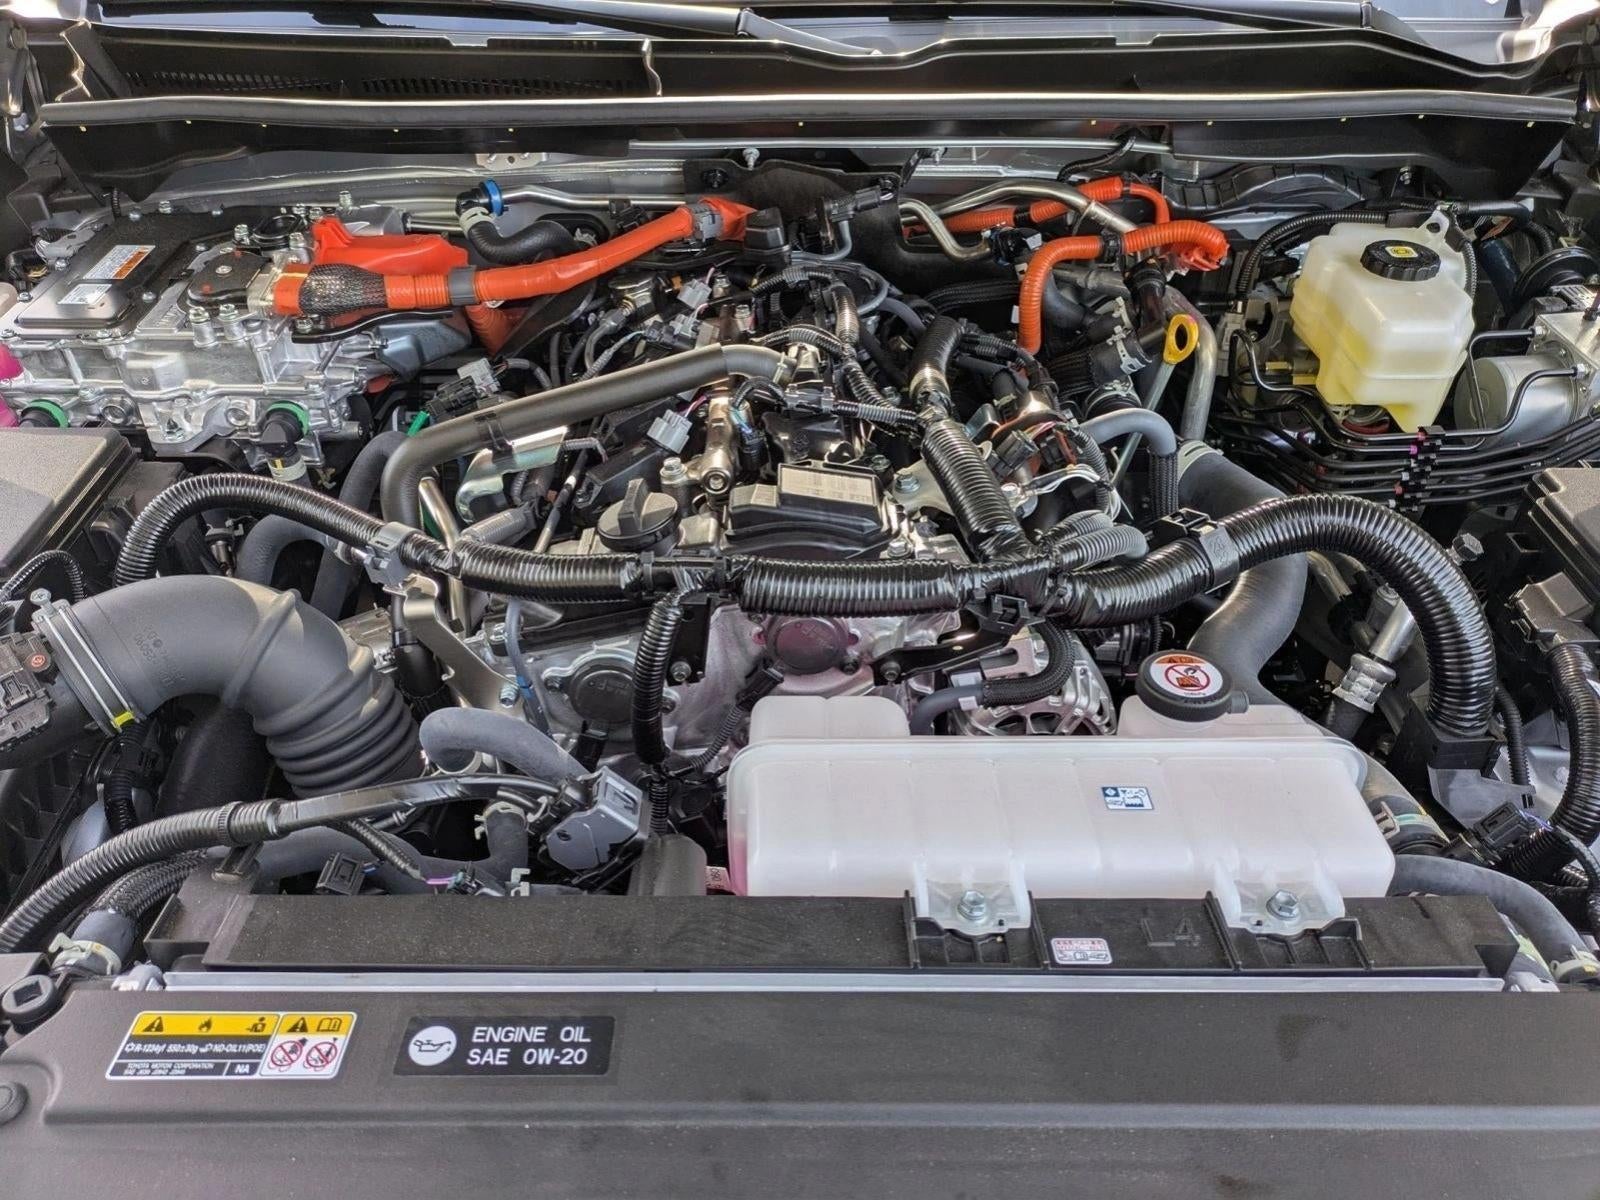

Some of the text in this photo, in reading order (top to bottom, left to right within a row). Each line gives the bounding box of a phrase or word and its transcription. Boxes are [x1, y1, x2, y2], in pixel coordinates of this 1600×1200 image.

[471, 1026, 592, 1043] ENGINE OIL
[466, 1048, 588, 1065] SAE 0W-20
[234, 1063, 250, 1074] NA
